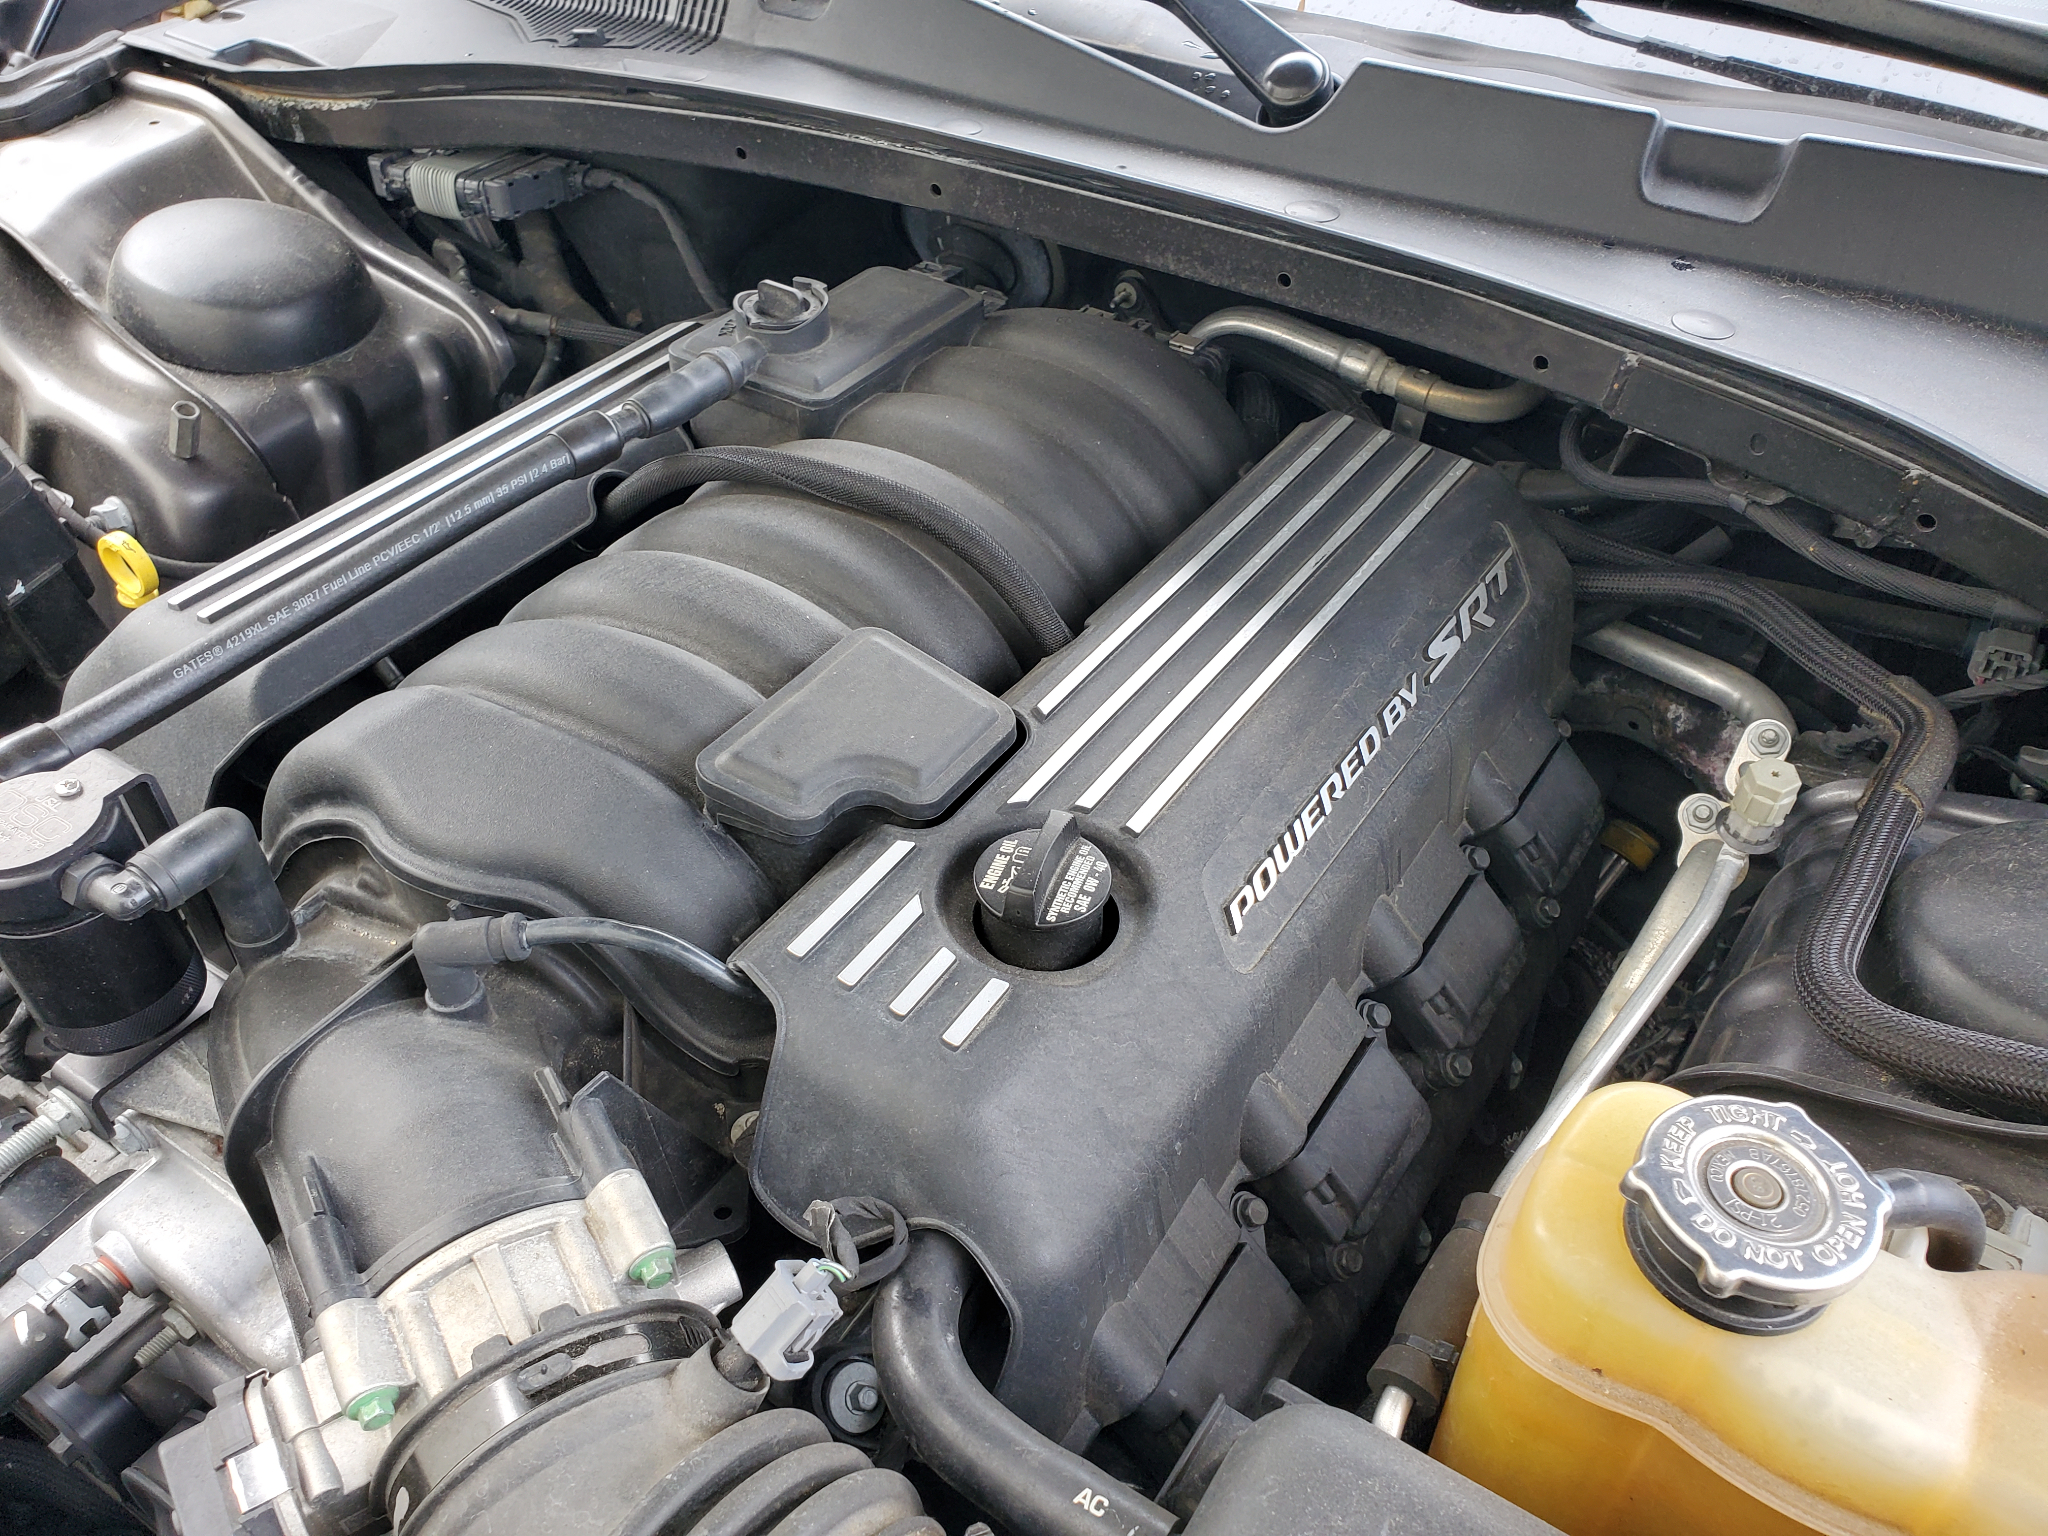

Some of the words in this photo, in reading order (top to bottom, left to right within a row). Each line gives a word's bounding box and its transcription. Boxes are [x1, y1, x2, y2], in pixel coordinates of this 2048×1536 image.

[226, 624, 268, 650] 4219XL
[267, 607, 292, 626] SAE
[292, 589, 321, 612] 30R7
[322, 575, 347, 595] Fuel
[347, 562, 372, 580] Line
[372, 533, 421, 566] PCV/EEC
[496, 484, 509, 497] 35
[510, 475, 528, 490] PSI
[1226, 726, 1381, 935] POWERED
[1380, 672, 1418, 738] BY
[1425, 547, 1514, 684] SRT
[979, 853, 1011, 890] ENGINE
[1000, 839, 1019, 855] OIL
[1046, 876, 1072, 922] SYNTHETIC
[1065, 854, 1085, 880] ENGINE
[1079, 844, 1092, 858] OIL
[1060, 855, 1096, 914] RECOMMENDED
[1074, 894, 1092, 913] SAE
[1660, 1116, 1696, 1173] KEEP
[1702, 1104, 1787, 1132] TIGHT
[1821, 1159, 1867, 1210] HOT
[1690, 1211, 1737, 1248] DO
[1743, 1241, 1804, 1272] NOT
[1811, 1210, 1868, 1267] OPEN
[1073, 1487, 1109, 1517] AC
